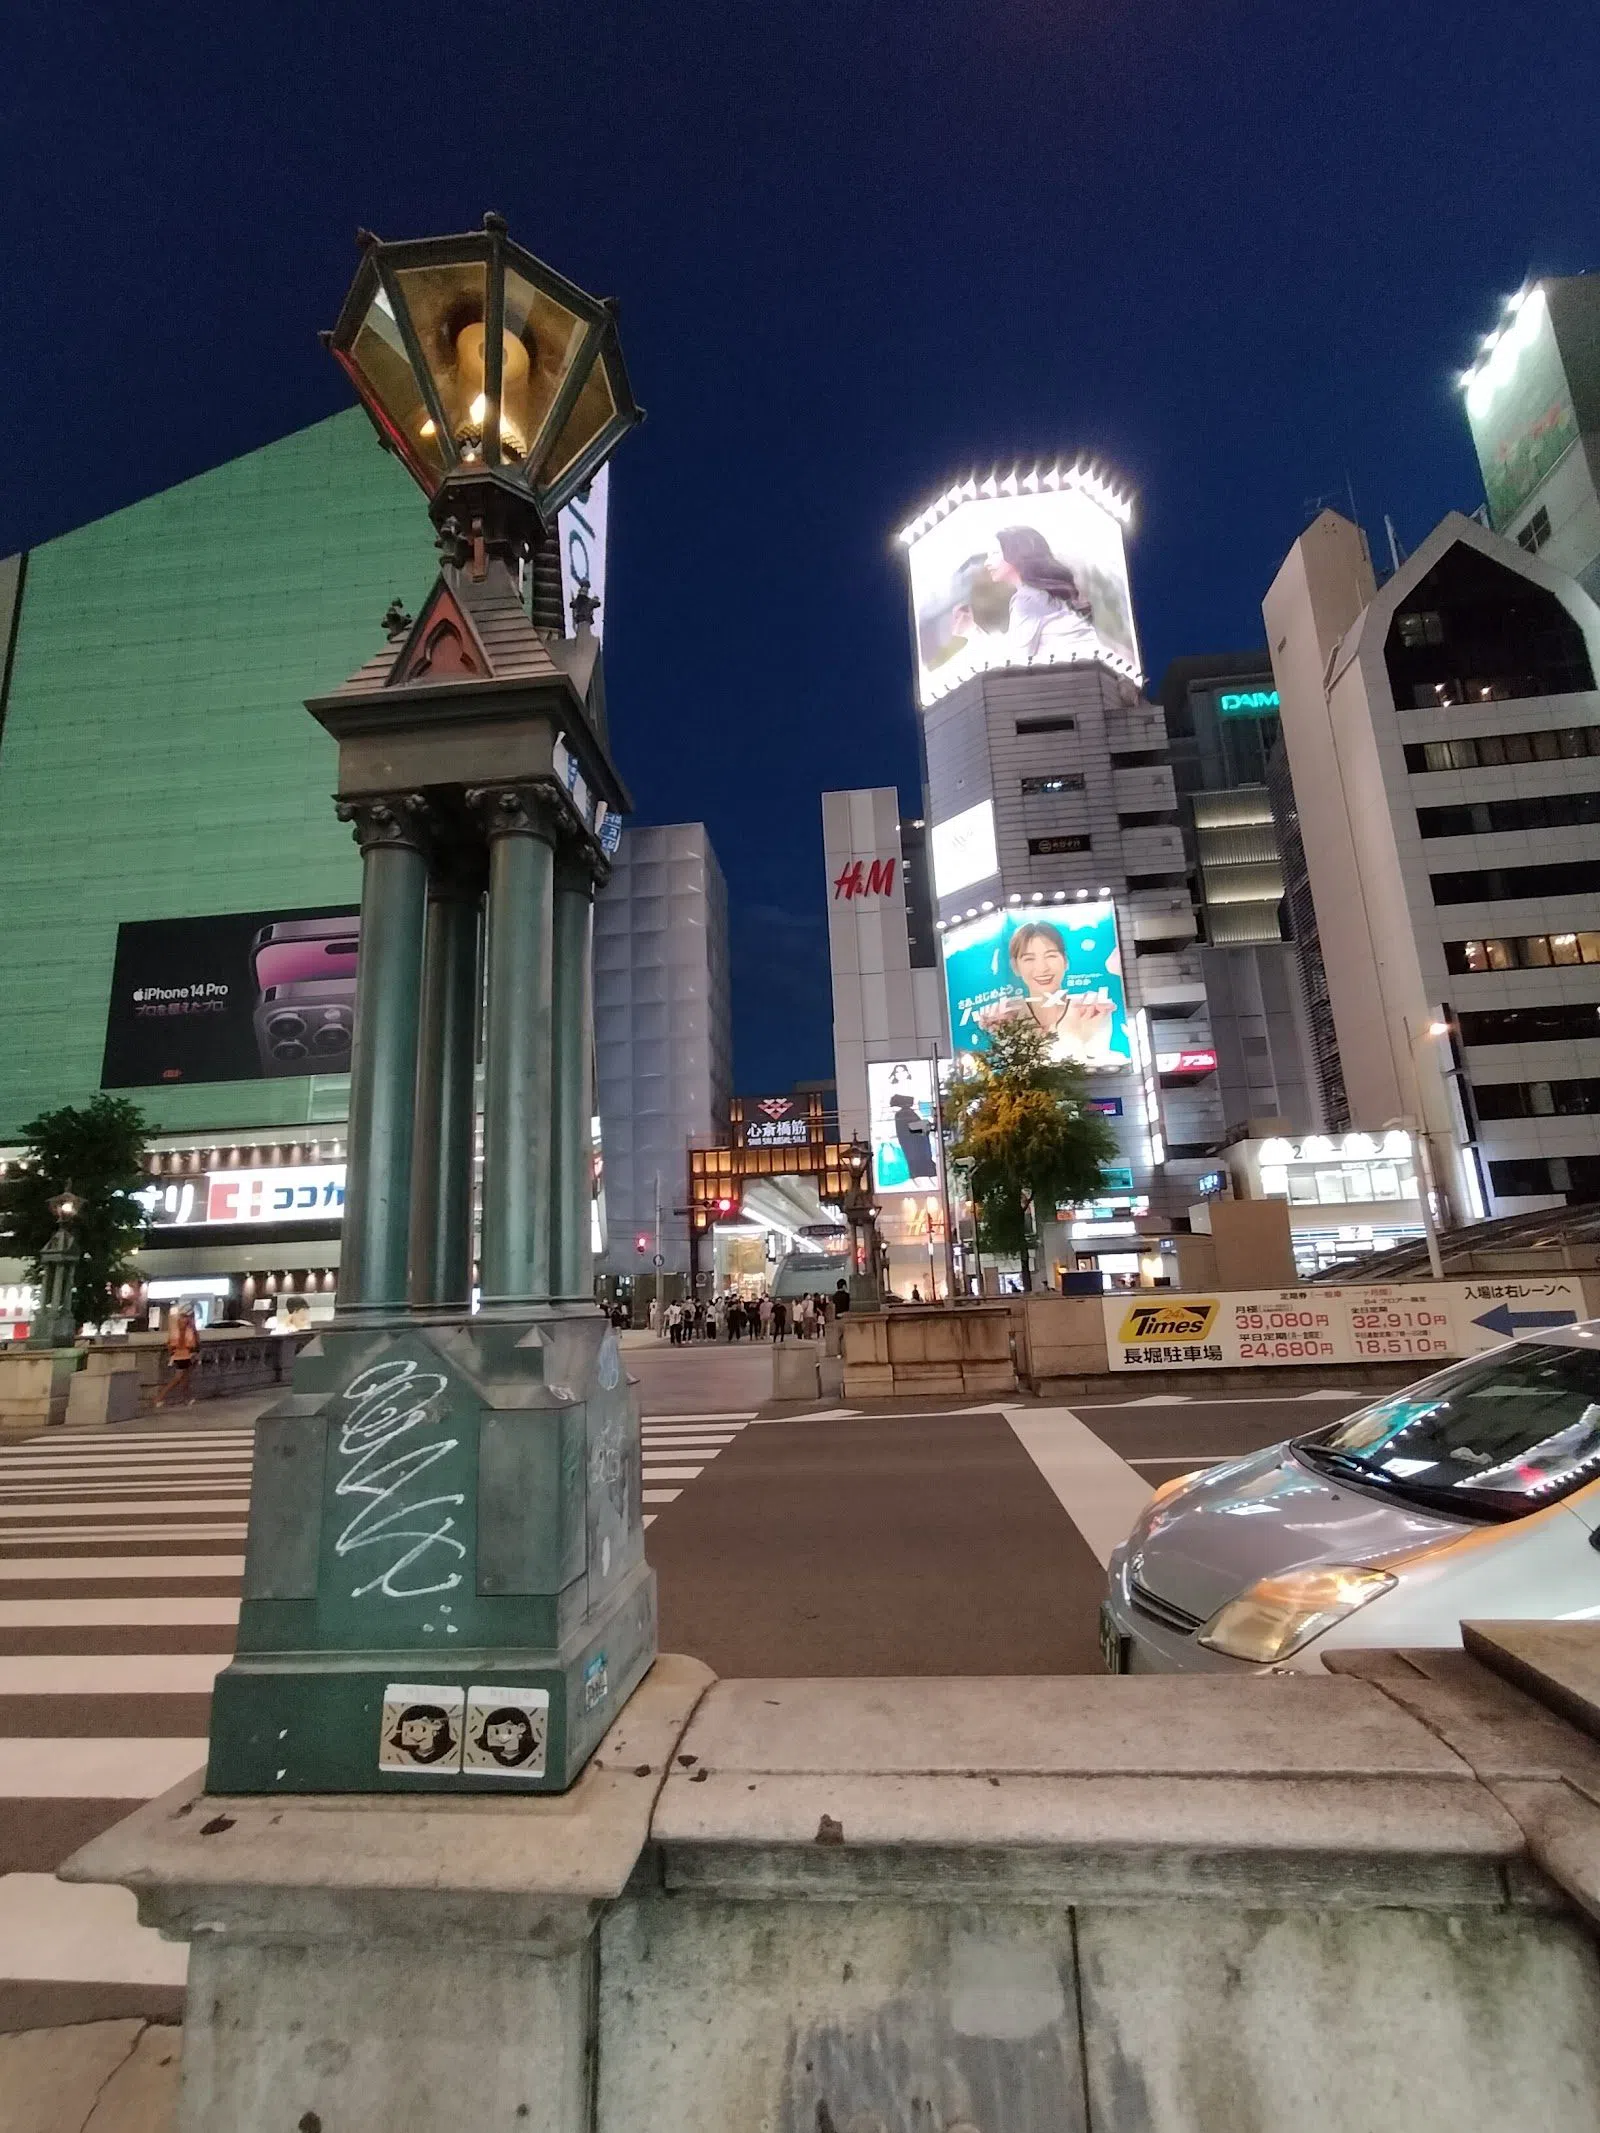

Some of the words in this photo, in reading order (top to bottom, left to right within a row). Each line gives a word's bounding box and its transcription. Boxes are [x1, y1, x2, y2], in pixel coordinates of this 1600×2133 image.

[834, 858, 896, 900] H&M
[144, 986, 189, 1000] iPhone
[190, 984, 204, 997] 14
[206, 983, 229, 996] Pro
[1464, 1284, 1571, 1300] 入場は右レーンへ
[1130, 1305, 1212, 1336] Times
[1124, 1345, 1223, 1365] 長堀駐車場
